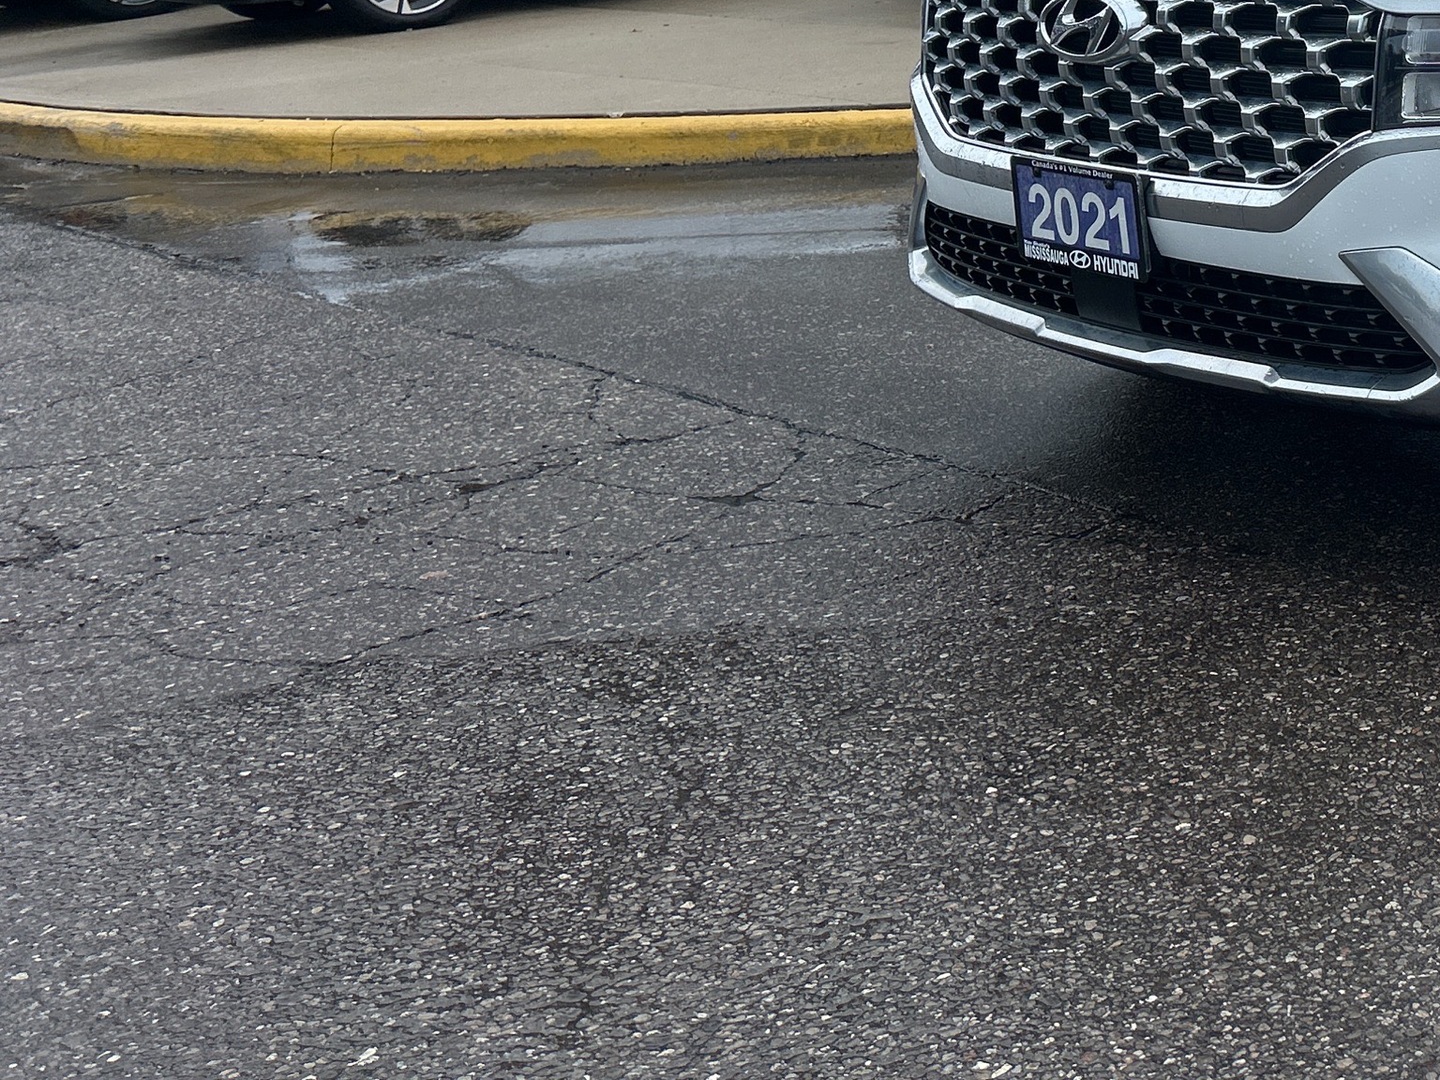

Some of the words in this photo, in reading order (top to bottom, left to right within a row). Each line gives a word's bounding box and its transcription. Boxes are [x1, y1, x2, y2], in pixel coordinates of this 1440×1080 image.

[1031, 159, 1058, 170] Canada's
[1059, 163, 1067, 172] #1
[1068, 164, 1092, 176] Volume
[1092, 169, 1113, 180] Dealer
[1028, 183, 1131, 255] 2021
[1024, 242, 1070, 266] MISSISSAUGA
[1093, 254, 1139, 280] HYUNDAI
